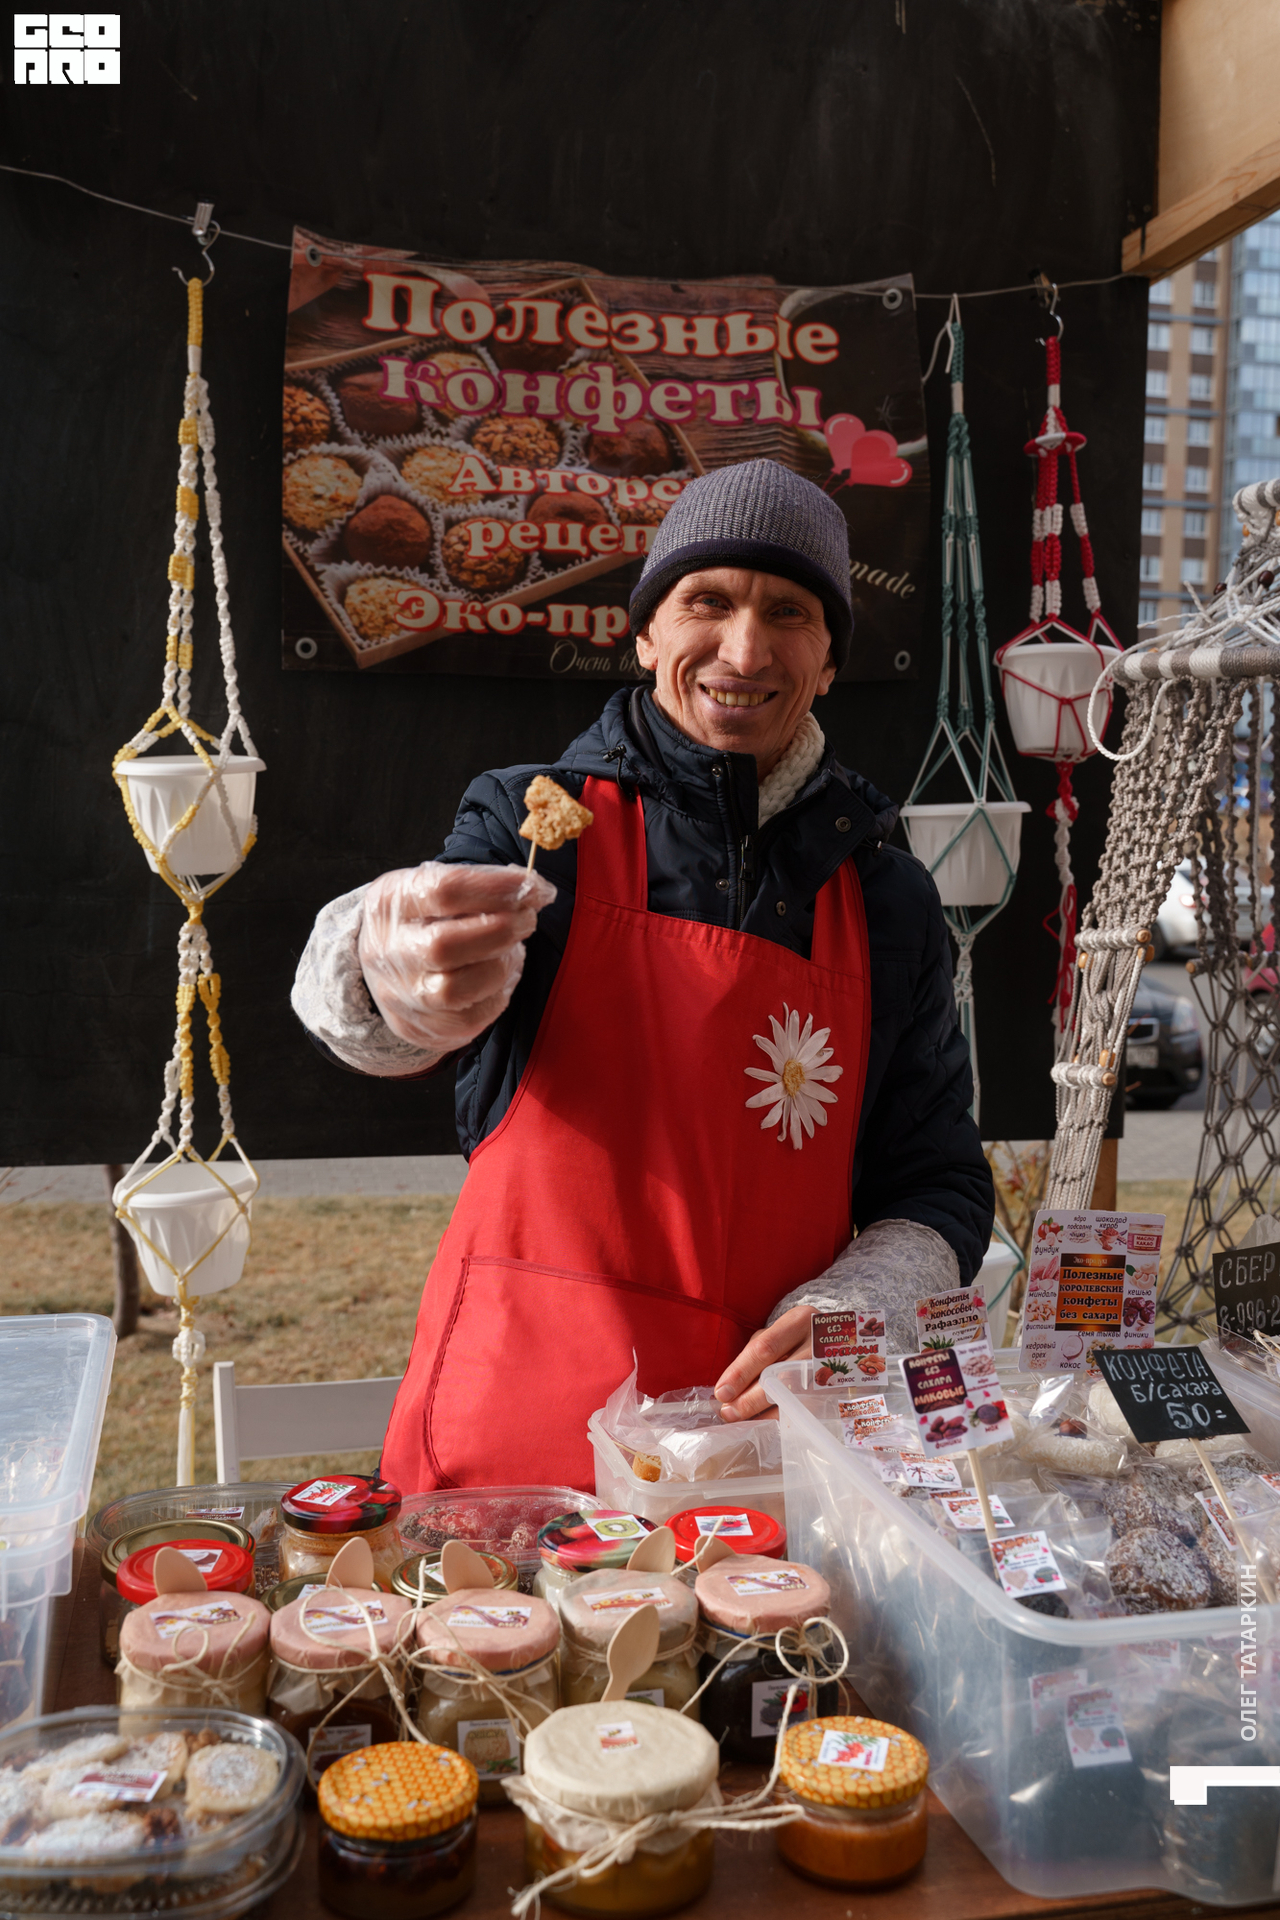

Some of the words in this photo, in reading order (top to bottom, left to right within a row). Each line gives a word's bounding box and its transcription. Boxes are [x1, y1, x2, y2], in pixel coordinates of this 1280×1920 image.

[362, 272, 840, 365] Полезные
[1095, 1215, 1128, 1224] шоколад
[1034, 1245, 1060, 1255] фундук
[1062, 1269, 1124, 1281] Полезные
[1219, 1251, 1276, 1289] СБЕР
[1028, 1290, 1057, 1298] миндаль
[1059, 1284, 1124, 1294] КОРОЛЕВСКИЕ
[1127, 1289, 1152, 1297] кешью
[929, 1293, 970, 1309] Конфеты
[1062, 1296, 1118, 1309] конфеты
[814, 1314, 856, 1325] КОНФЕТЫ
[1059, 1310, 1077, 1320] без
[1082, 1311, 1118, 1321] сахара
[924, 1314, 979, 1332] Рафаэлло
[1025, 1323, 1054, 1331] фисташки
[827, 1324, 842, 1334] БЕЗ
[819, 1335, 850, 1344] САХАРА
[825, 1344, 879, 1357] ОРЕХОВЫЕ
[1025, 1342, 1056, 1350] кедровый
[908, 1352, 951, 1370] КОНФЕТЫ
[1031, 1352, 1046, 1361] орех
[924, 1365, 941, 1377] БЕЗ
[917, 1375, 953, 1390] САХАРА
[913, 1385, 966, 1407] МАКОВЫЕ
